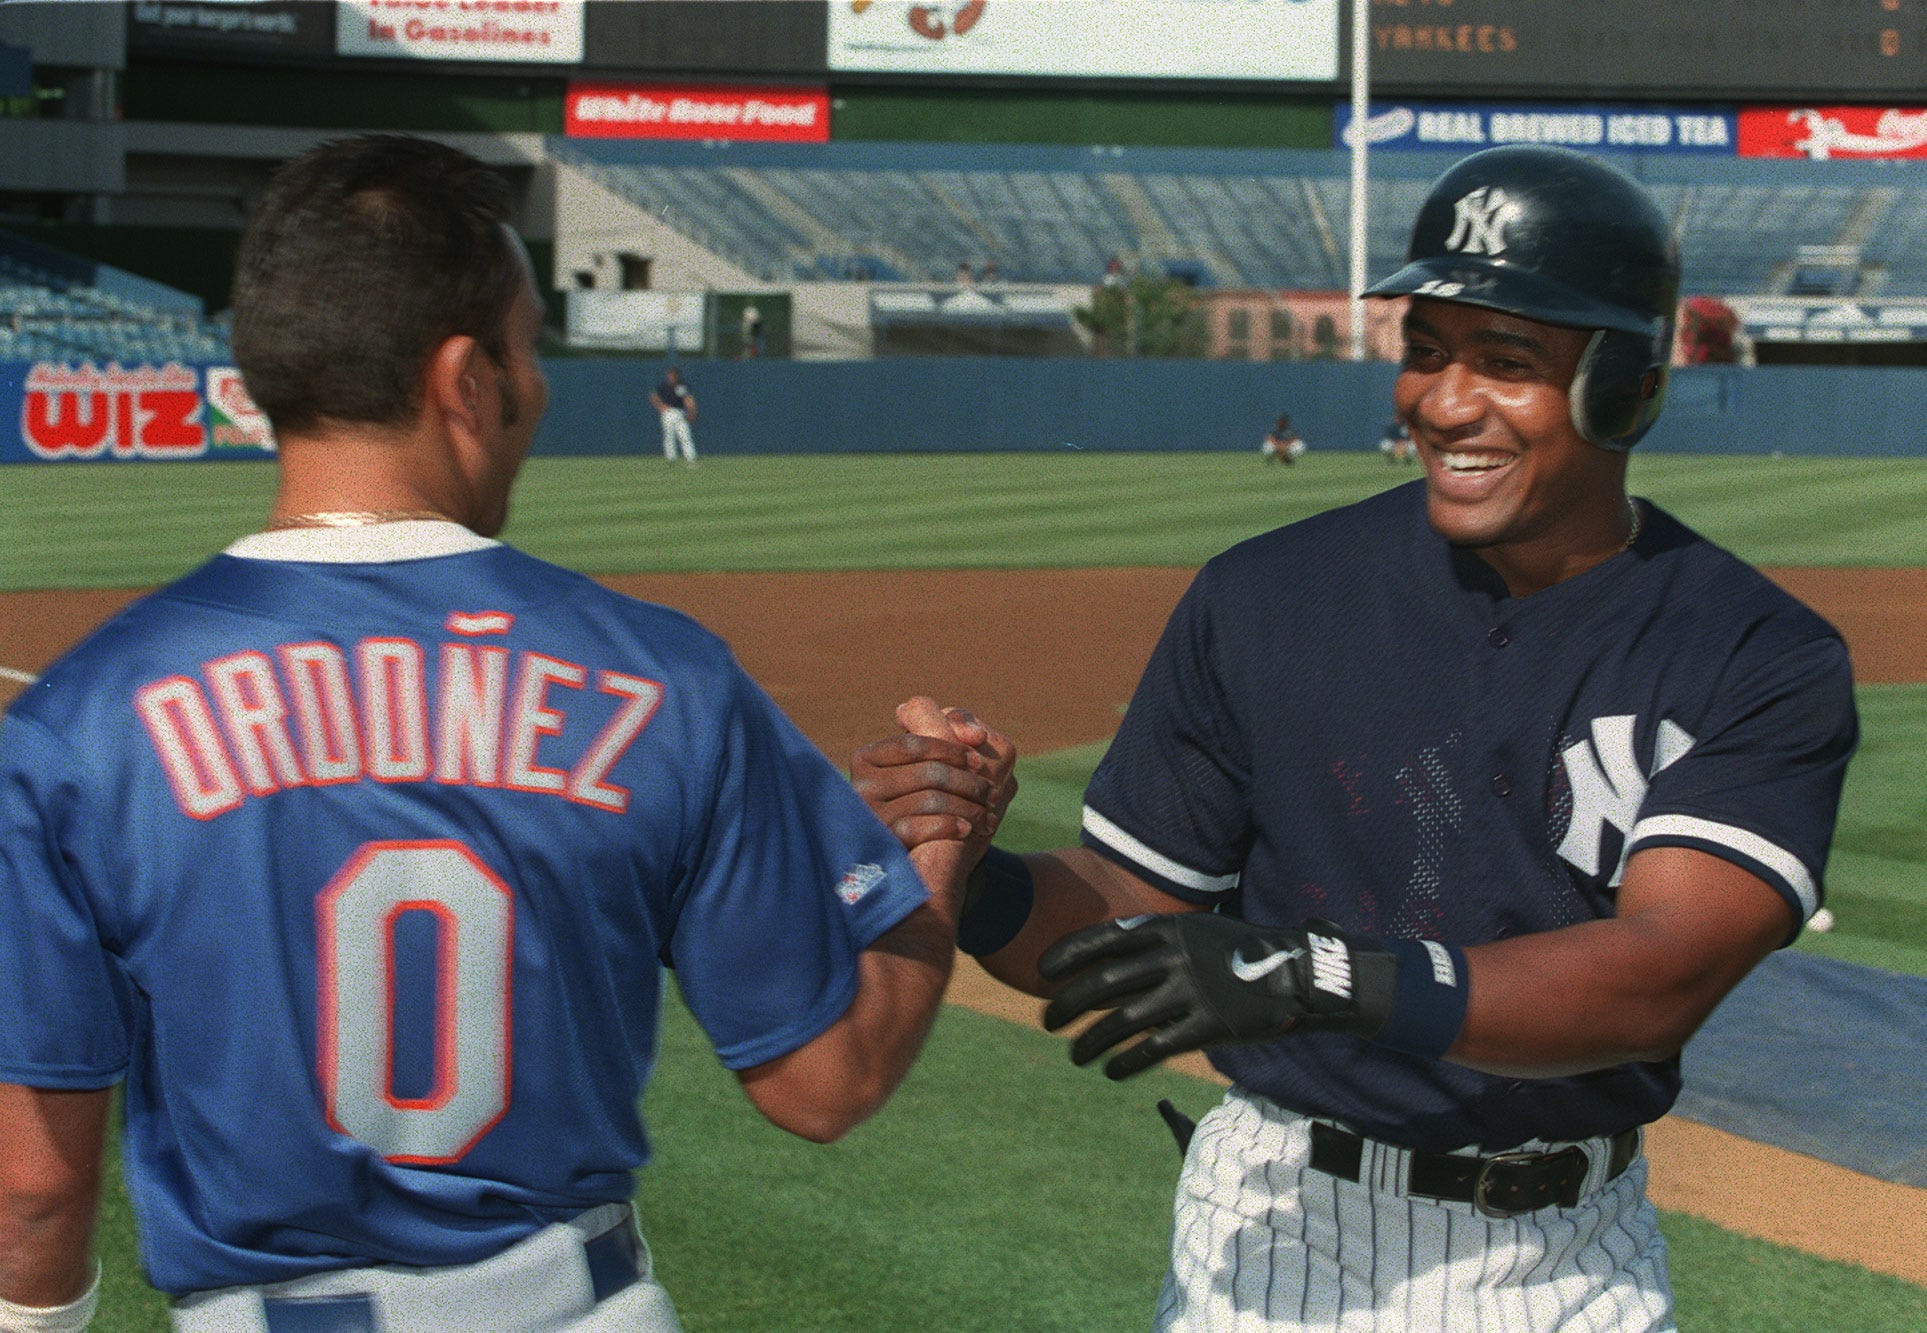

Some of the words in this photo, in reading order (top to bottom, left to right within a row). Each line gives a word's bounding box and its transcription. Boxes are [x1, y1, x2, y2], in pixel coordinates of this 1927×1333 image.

[404, 18, 551, 46] Gasolines
[1373, 25, 1518, 51] YANKEES
[1417, 111, 1485, 142] REAL
[1491, 112, 1602, 144] BREWED
[1606, 114, 1671, 144] ICED
[1675, 115, 1729, 145] TEA
[1445, 186, 1522, 256] NY
[22, 387, 207, 457] WIZ
[134, 610, 665, 820] ORDOÑEZ
[1307, 931, 1352, 1000] NIKE
[314, 838, 513, 1165] 0
